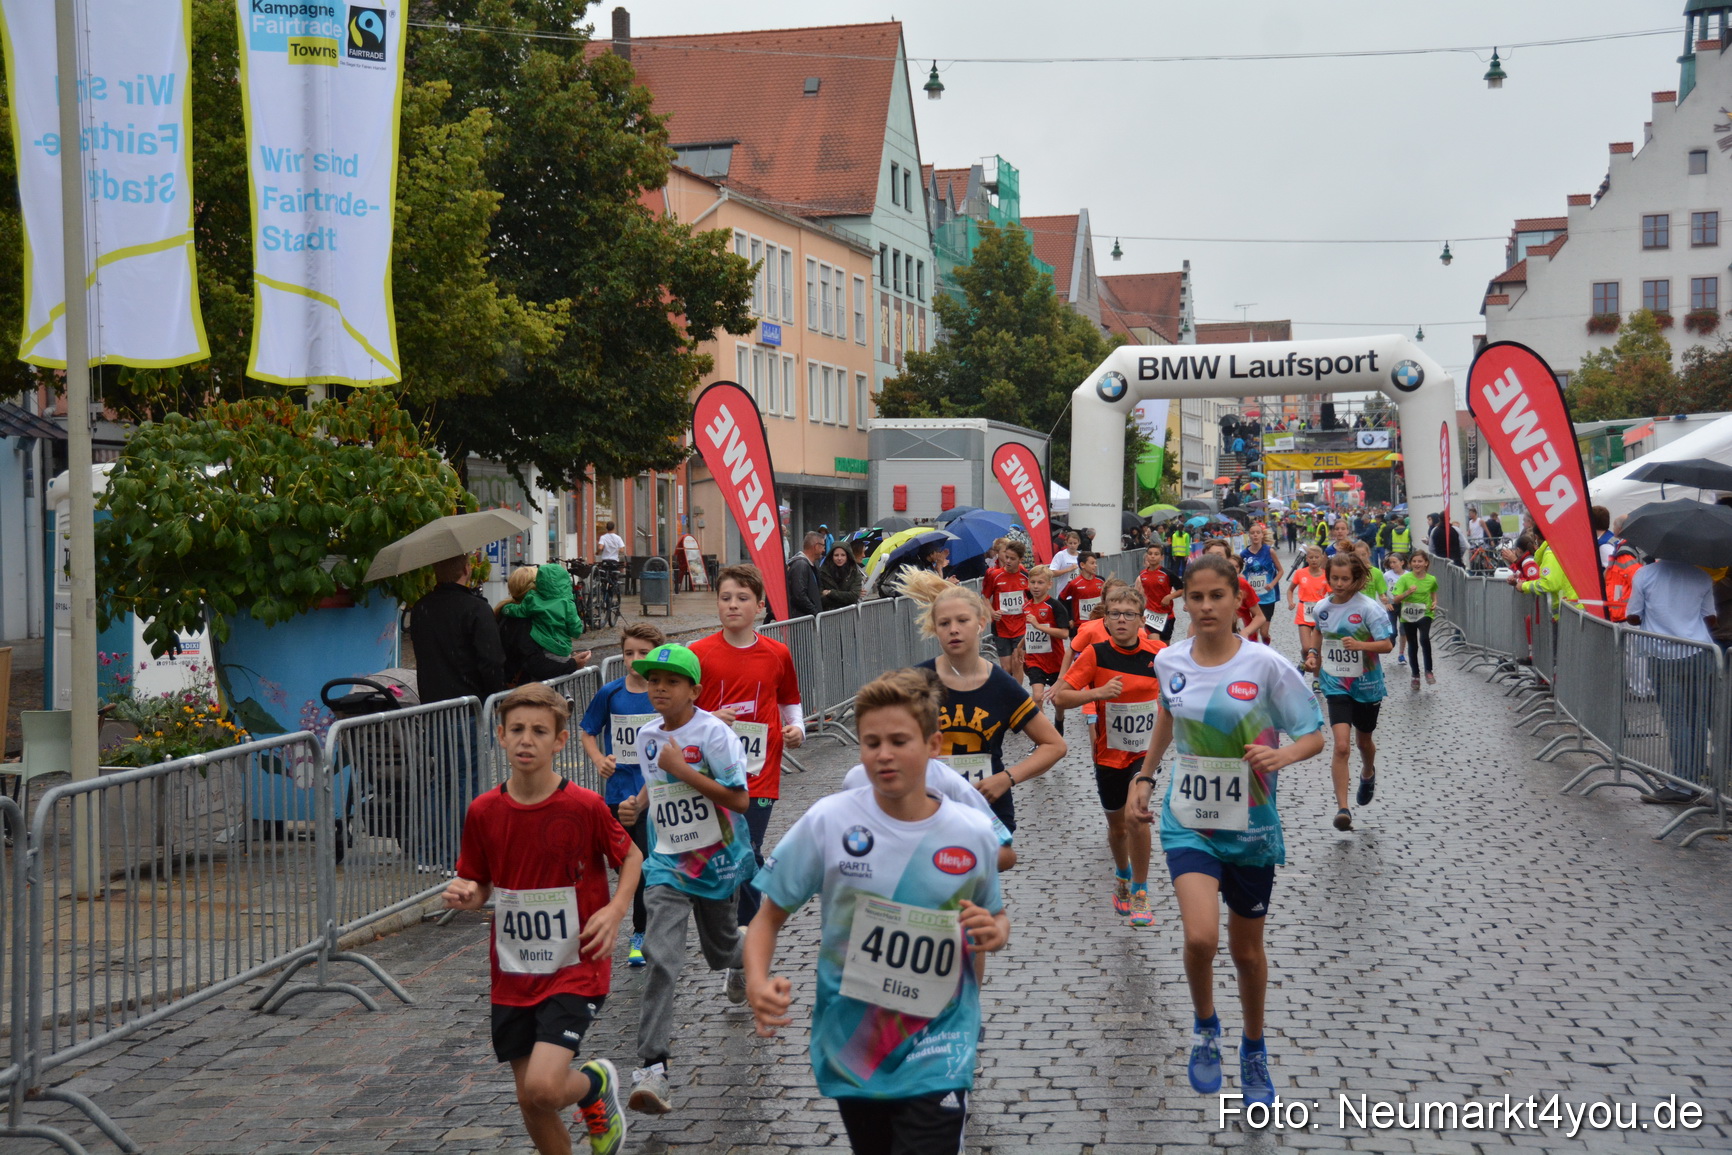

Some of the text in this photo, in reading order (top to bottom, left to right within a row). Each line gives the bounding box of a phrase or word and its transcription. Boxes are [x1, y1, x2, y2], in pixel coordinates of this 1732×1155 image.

[252, 0, 335, 18] Kampagne
[252, 15, 343, 37] Fairtrade
[290, 43, 337, 59] Towns
[348, 48, 384, 60] FAIRTRADE
[260, 145, 359, 178] Wir sind
[262, 226, 337, 252] Stadt
[1138, 350, 1379, 381] BMW Laufsport
[1314, 455, 1343, 467] ZIEL
[488, 541, 497, 553] P
[1002, 596, 1023, 607] 4018
[1327, 648, 1359, 663] 4039
[1231, 685, 1256, 696] Hervis
[1112, 713, 1154, 734] 4028
[1179, 773, 1242, 802] 4014
[656, 795, 709, 828] 4035
[1195, 807, 1219, 819] Sara
[669, 830, 699, 844] Karam
[711, 854, 730, 867] 17.
[839, 861, 873, 873] PARTL
[938, 852, 973, 868] Hervis
[503, 908, 568, 941] 4001
[519, 948, 553, 962] Moritz
[861, 925, 955, 977] 4000
[882, 977, 920, 1000] Elias
[563, 1029, 580, 1040] JAKO
[905, 1042, 952, 1063] Stadtlauf
